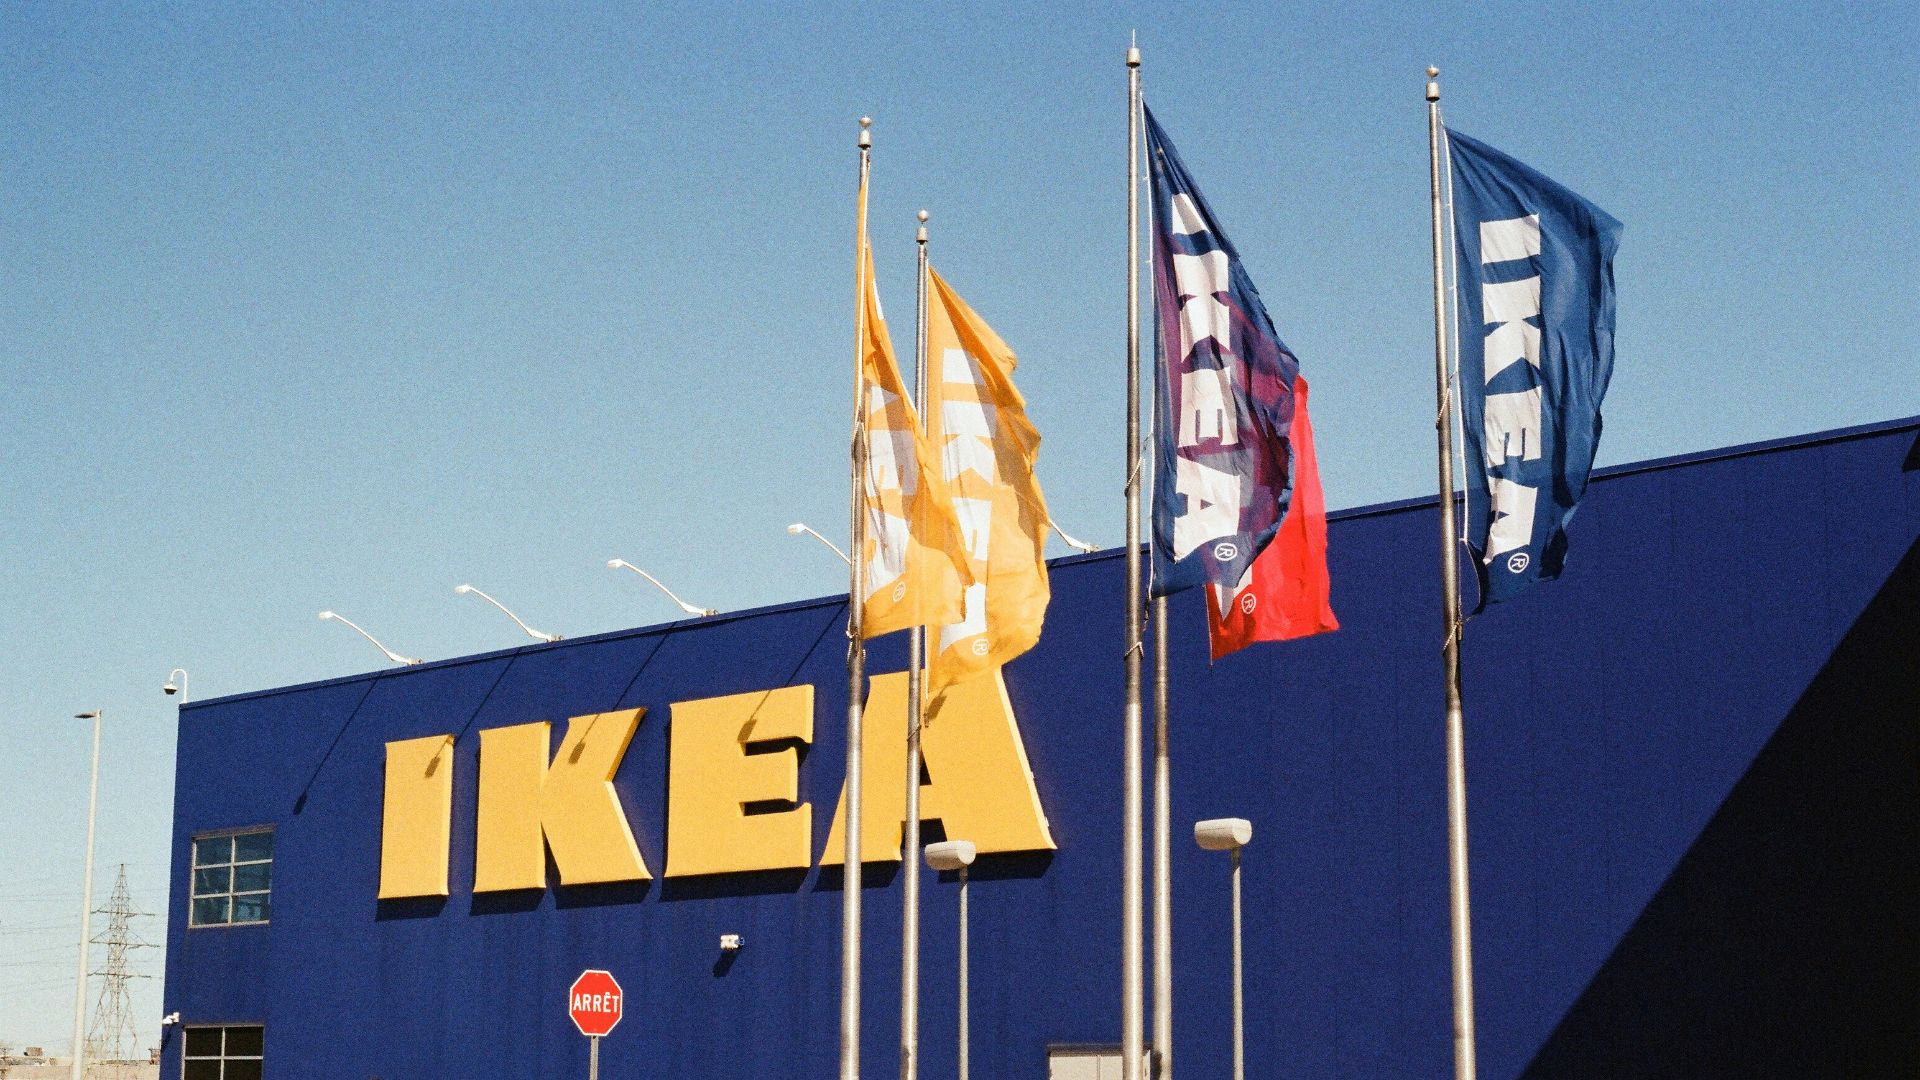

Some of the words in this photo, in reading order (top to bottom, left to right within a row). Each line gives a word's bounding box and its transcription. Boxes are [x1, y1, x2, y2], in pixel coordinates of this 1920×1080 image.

[1479, 213, 1541, 566] IKEA
[378, 665, 1058, 900] IKEA
[573, 991, 619, 1013] ARRÊT
